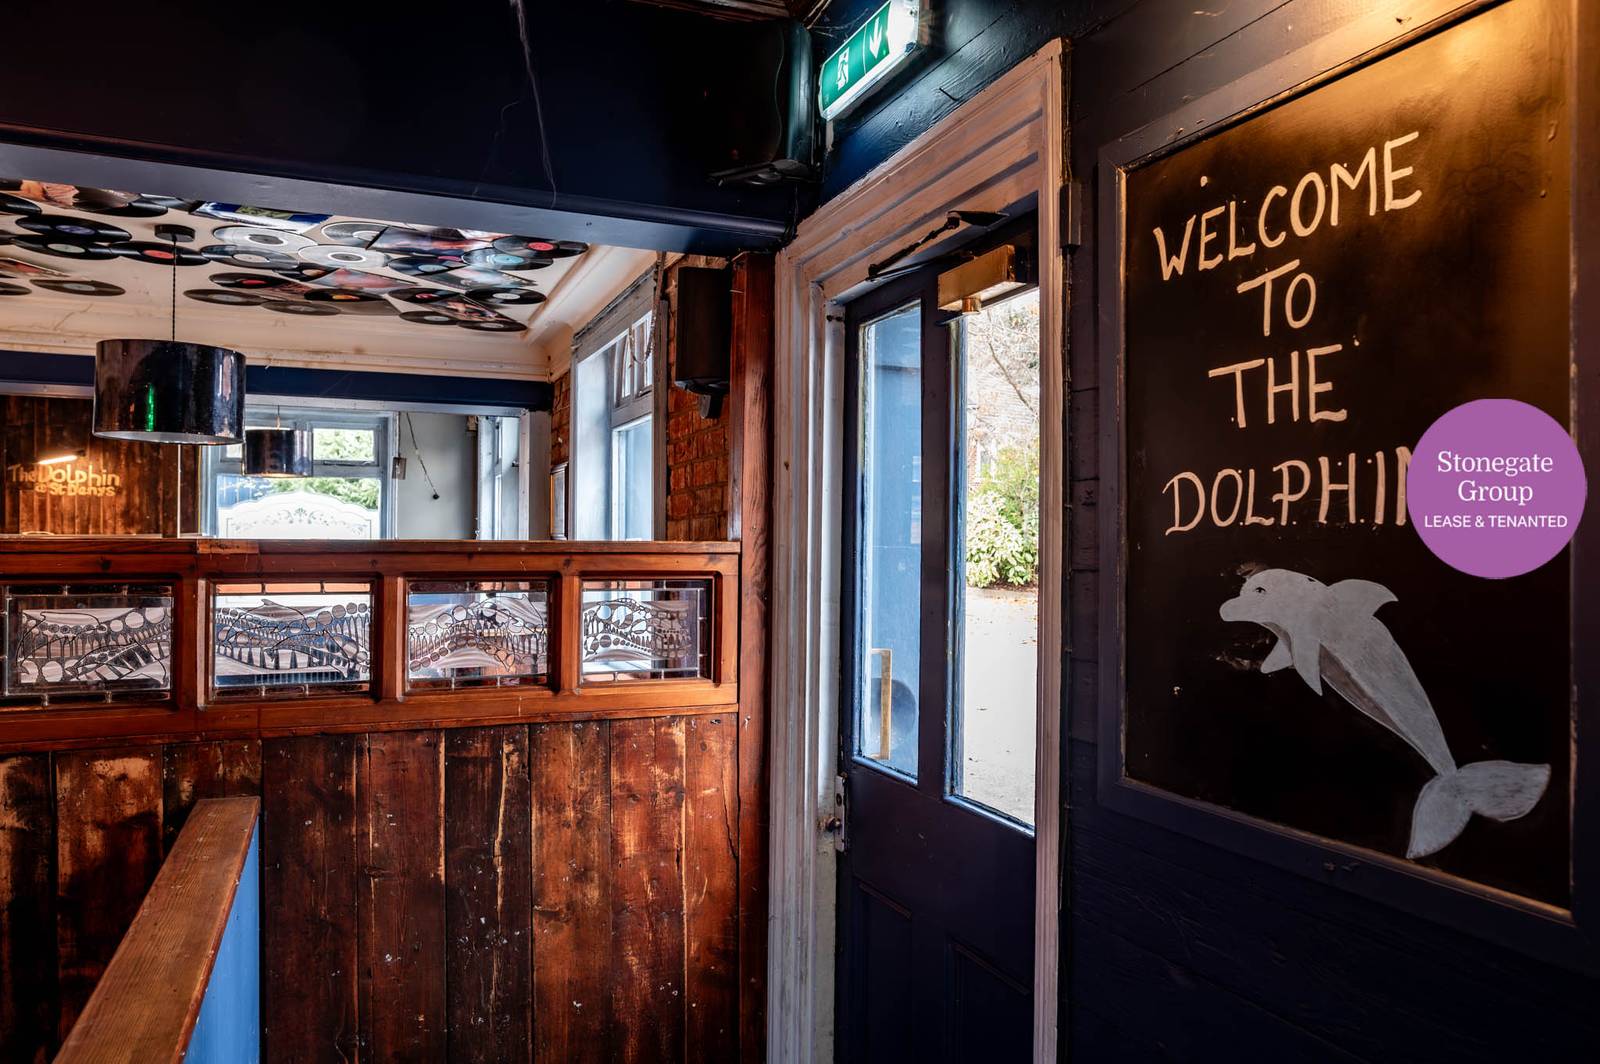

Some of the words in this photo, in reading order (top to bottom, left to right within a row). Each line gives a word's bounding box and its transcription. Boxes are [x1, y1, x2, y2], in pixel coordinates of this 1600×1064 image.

[1152, 131, 1423, 281] WELCOME
[1236, 258, 1317, 337] TO
[1208, 343, 1348, 429] THE
[38, 463, 120, 487] Dolphin
